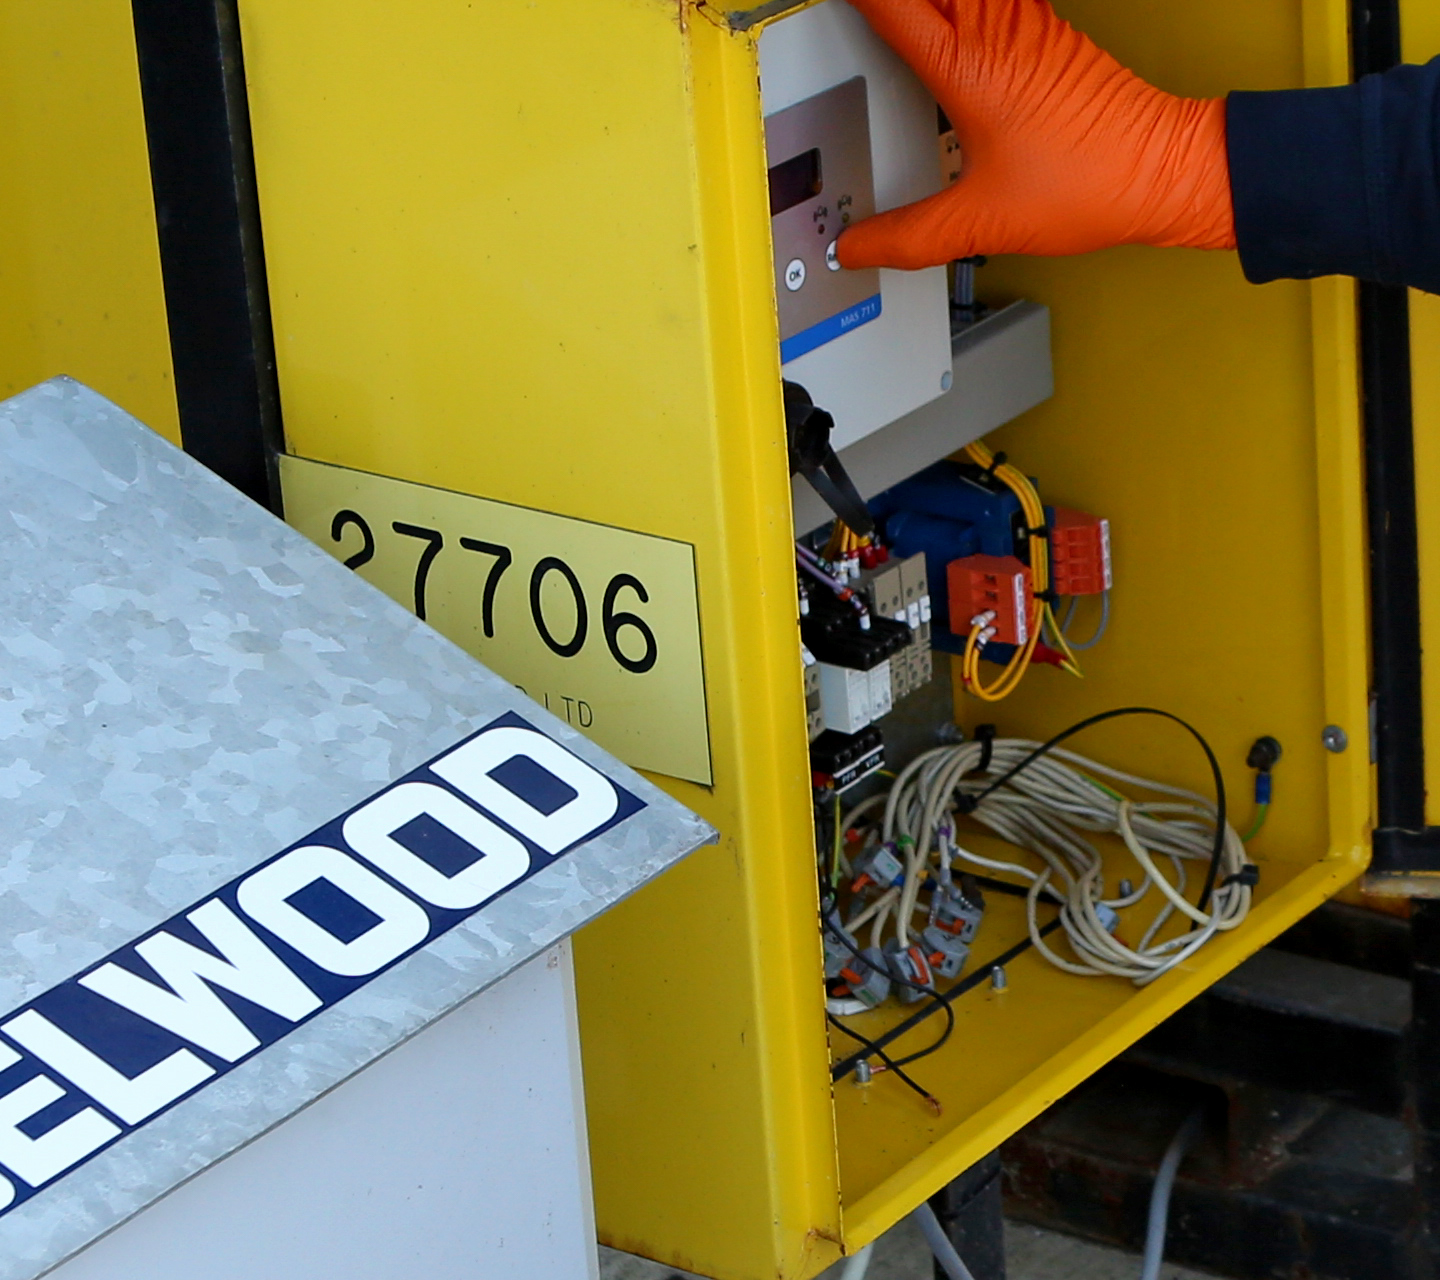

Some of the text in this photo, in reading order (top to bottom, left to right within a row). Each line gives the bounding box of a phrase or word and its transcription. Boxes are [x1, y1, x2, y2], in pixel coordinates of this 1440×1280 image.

[789, 268, 802, 282] OK
[840, 312, 860, 328] MAS
[330, 509, 658, 675] 27706
